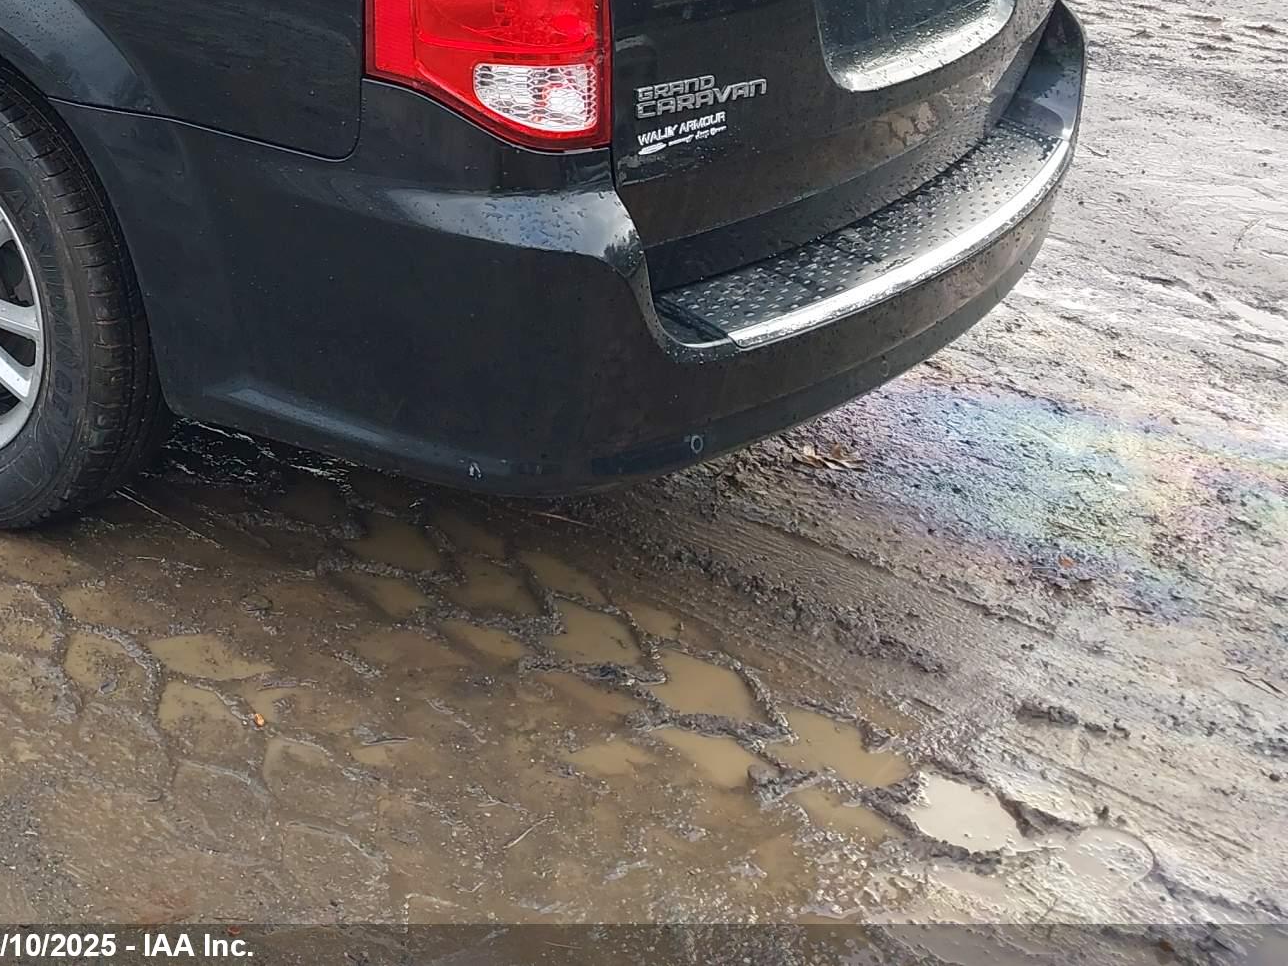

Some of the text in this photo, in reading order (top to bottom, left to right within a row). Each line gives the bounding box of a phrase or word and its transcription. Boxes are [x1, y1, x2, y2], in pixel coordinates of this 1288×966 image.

[634, 74, 715, 102] GRAND
[635, 78, 767, 119] CARAVAN
[678, 111, 726, 135] ARMOUR
